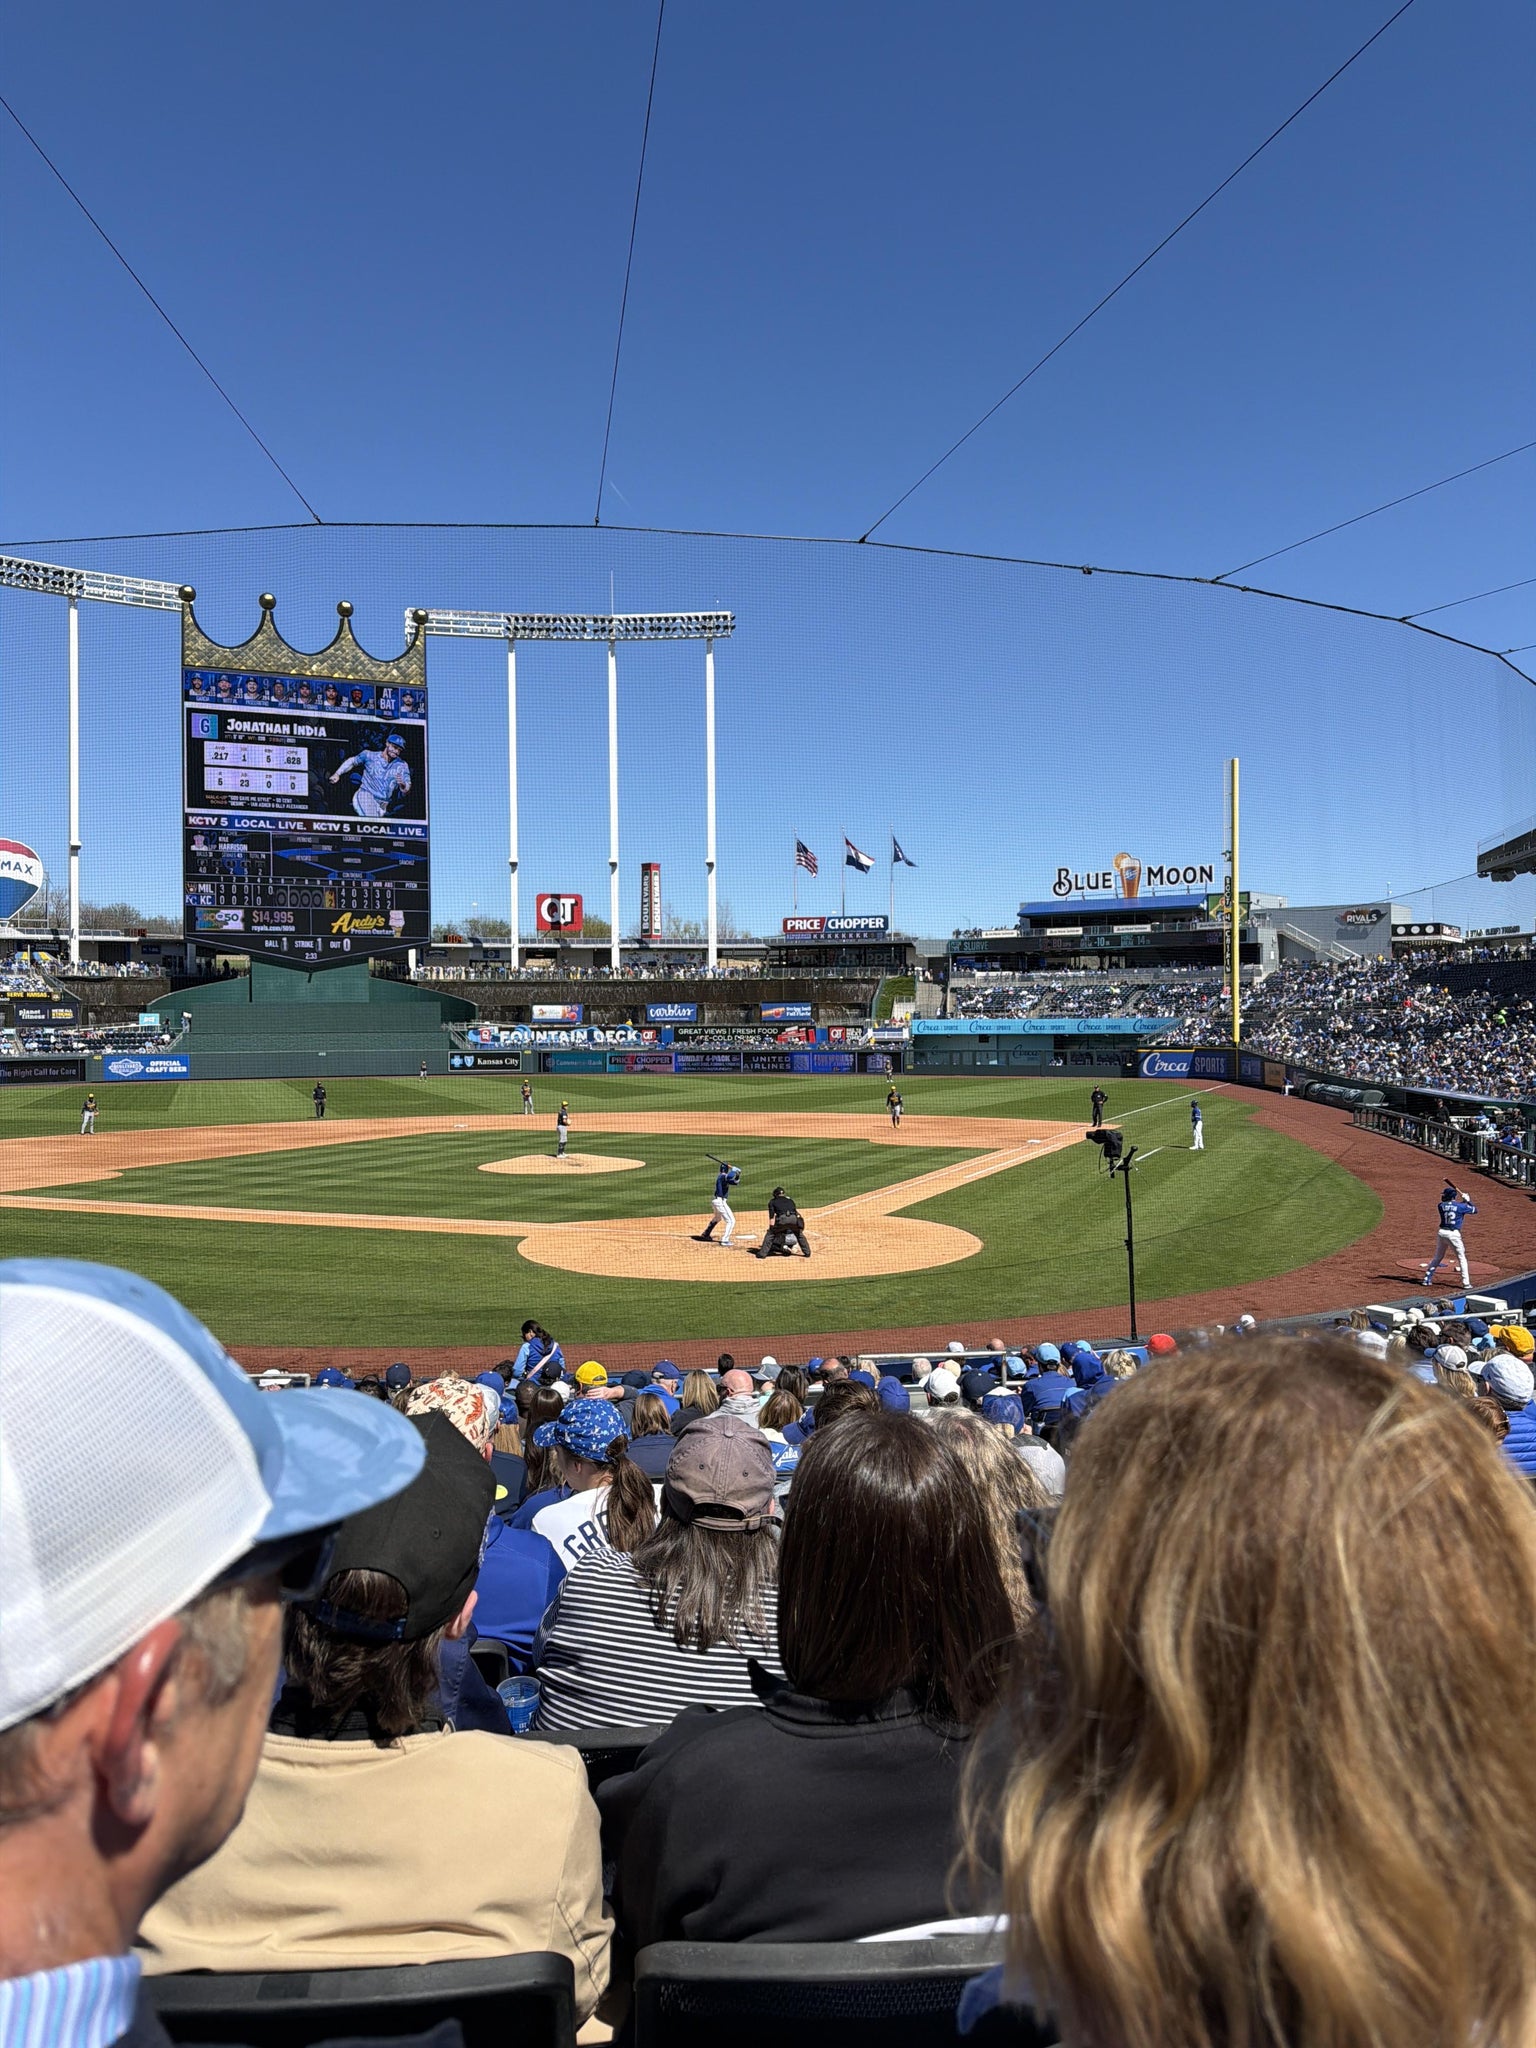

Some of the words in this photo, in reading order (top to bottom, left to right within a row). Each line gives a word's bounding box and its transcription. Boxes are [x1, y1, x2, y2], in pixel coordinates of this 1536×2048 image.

[383, 688, 393, 698] AT
[380, 699, 395, 710] BAT
[227, 718, 291, 734] JONATHAN
[294, 723, 327, 737] INDIA
[211, 752, 228, 761] .217
[284, 757, 301, 765] .628
[240, 779, 250, 788] 23
[266, 781, 272, 789] 0
[188, 816, 217, 825] KCTV
[220, 817, 228, 826] 5
[235, 819, 275, 829] LOCAL.
[278, 821, 307, 830] LIVE.
[313, 822, 340, 832] KCTV
[343, 823, 350, 832] 5
[357, 825, 396, 835] LOCAL.
[398, 827, 425, 836] LIVE.
[218, 843, 248, 851] HARRISON
[1, 860, 33, 876] MAX
[1053, 868, 1112, 896] BLUE
[1147, 865, 1213, 887] MOON
[198, 884, 213, 893] MIL
[220, 885, 225, 893] 3
[232, 885, 237, 894] 0
[244, 885, 249, 894] 0
[268, 886, 273, 895] 0
[341, 889, 346, 897] 4
[352, 889, 357, 898] 0
[364, 889, 368, 898] 3
[376, 890, 380, 898] 3
[386, 890, 391, 898] 0
[200, 895, 212, 904] KC
[220, 896, 225, 905] 0
[232, 896, 237, 905] 0
[244, 896, 249, 905] 2
[256, 896, 261, 905] 0
[341, 900, 346, 908] 2
[352, 900, 357, 908] 0
[364, 900, 368, 909] 2
[376, 901, 380, 909] 3
[387, 901, 391, 909] 2
[252, 910, 294, 924] $14,995
[541, 898, 575, 925] QT
[331, 912, 385, 933] Andy's
[787, 919, 821, 930] PRICE
[828, 918, 884, 929] CHOPPER
[1347, 914, 1377, 923] RIVALS
[265, 940, 279, 948] BALL
[281, 937, 288, 951] 1
[294, 940, 314, 948] STRIKE
[316, 938, 322, 952] 1
[343, 938, 351, 952] 0
[19, 1008, 40, 1016] planet
[650, 1004, 694, 1017] carbliss
[917, 1020, 940, 1033] Circa
[969, 1020, 992, 1033] Circa
[1023, 1020, 1046, 1032] Circa
[1077, 1020, 1101, 1032] Circa
[1133, 1019, 1157, 1032] Circa
[500, 1030, 587, 1043] FOUNTAIN
[594, 1030, 638, 1042] DECK
[643, 1031, 655, 1039] QT
[831, 1029, 843, 1039] QT
[505, 1057, 519, 1067] City
[611, 1056, 631, 1064] PRICE
[636, 1056, 670, 1064] CHOPPER
[1143, 1053, 1190, 1076] Circa
[1195, 1057, 1224, 1073] SPORTS
[14, 1068, 33, 1078] Right
[34, 1068, 48, 1076] Call
[49, 1067, 59, 1076] for
[60, 1067, 76, 1076] Care
[1444, 1212, 1456, 1225] 12
[772, 1446, 798, 1467] yals
